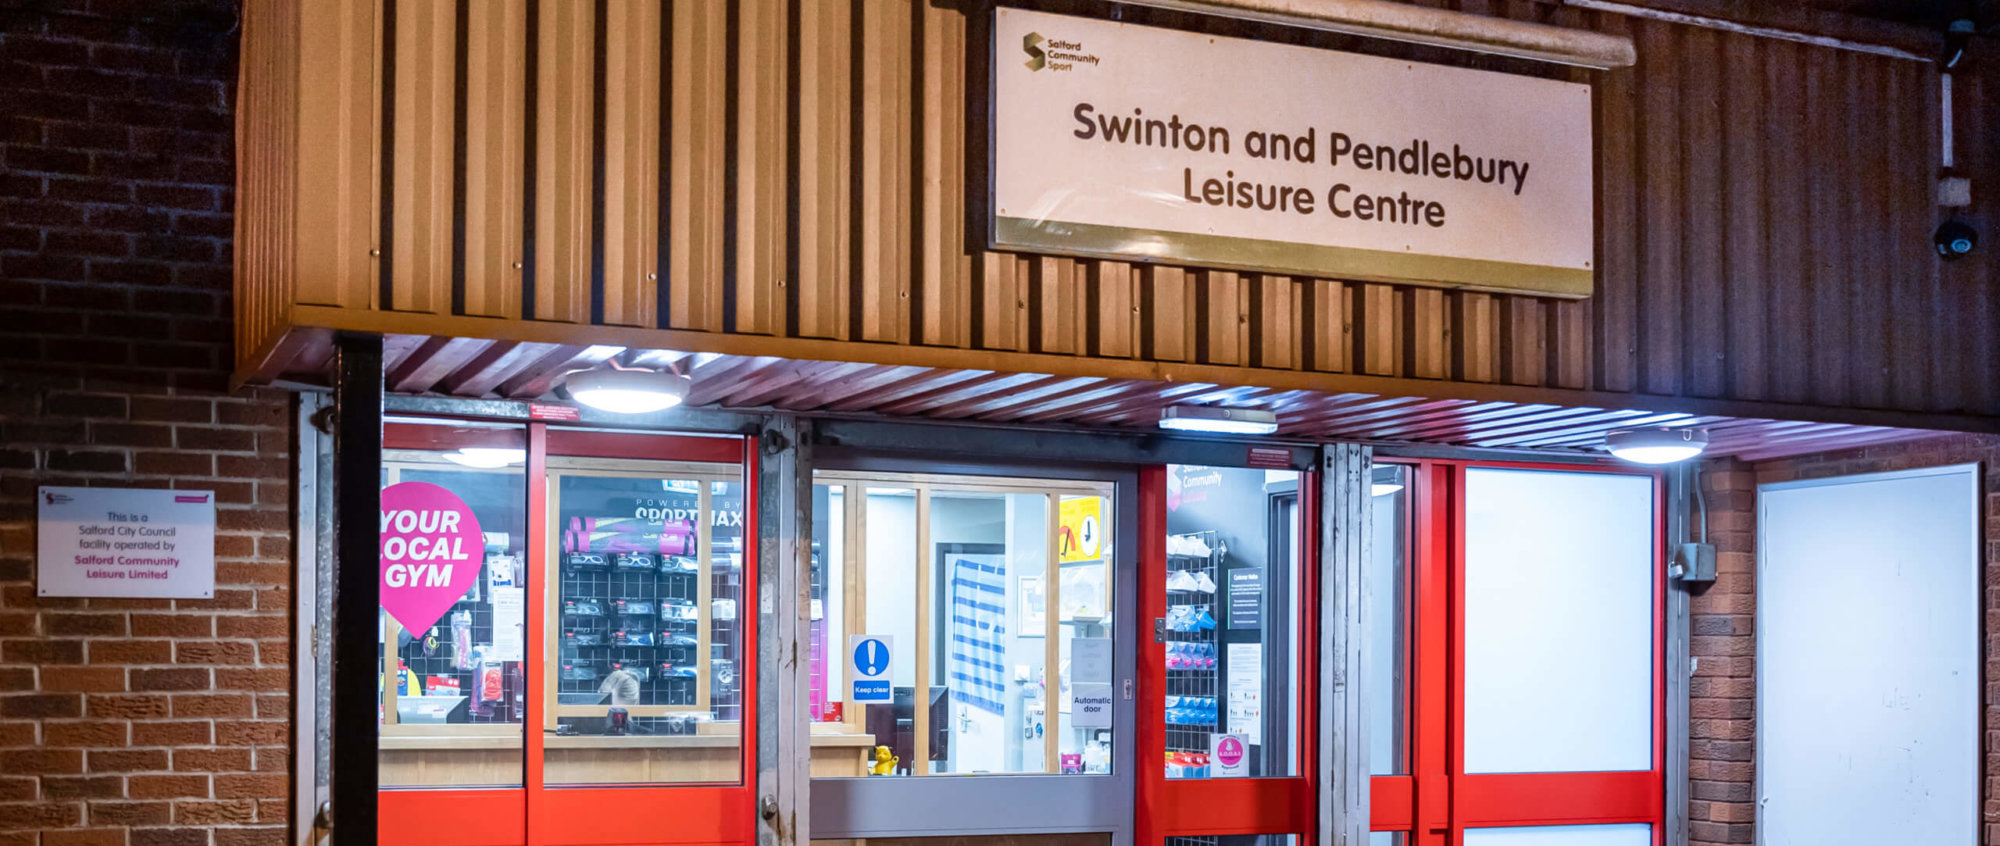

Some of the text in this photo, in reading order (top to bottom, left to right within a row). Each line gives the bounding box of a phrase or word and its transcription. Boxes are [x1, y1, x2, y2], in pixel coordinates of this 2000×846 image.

[1047, 39, 1082, 51] Salford
[1047, 50, 1100, 67] Community
[1047, 61, 1073, 72] Sport
[1073, 102, 1529, 196] Swinton and Pendlebury
[1184, 167, 1446, 228] Leisure Centre
[1182, 471, 1223, 489] Community
[724, 501, 741, 509] BY
[107, 512, 148, 522] This is a
[380, 509, 461, 534] YOUR
[635, 507, 742, 527] SPORTAX
[78, 525, 176, 538] Salford City Council
[79, 539, 176, 552] facility operated by
[380, 536, 469, 561] OCAL
[74, 555, 179, 568] Salford Community
[86, 569, 168, 580] Leisure Limited
[385, 563, 454, 588] GYM
[855, 686, 872, 694] Keep
[1083, 704, 1102, 713] door
